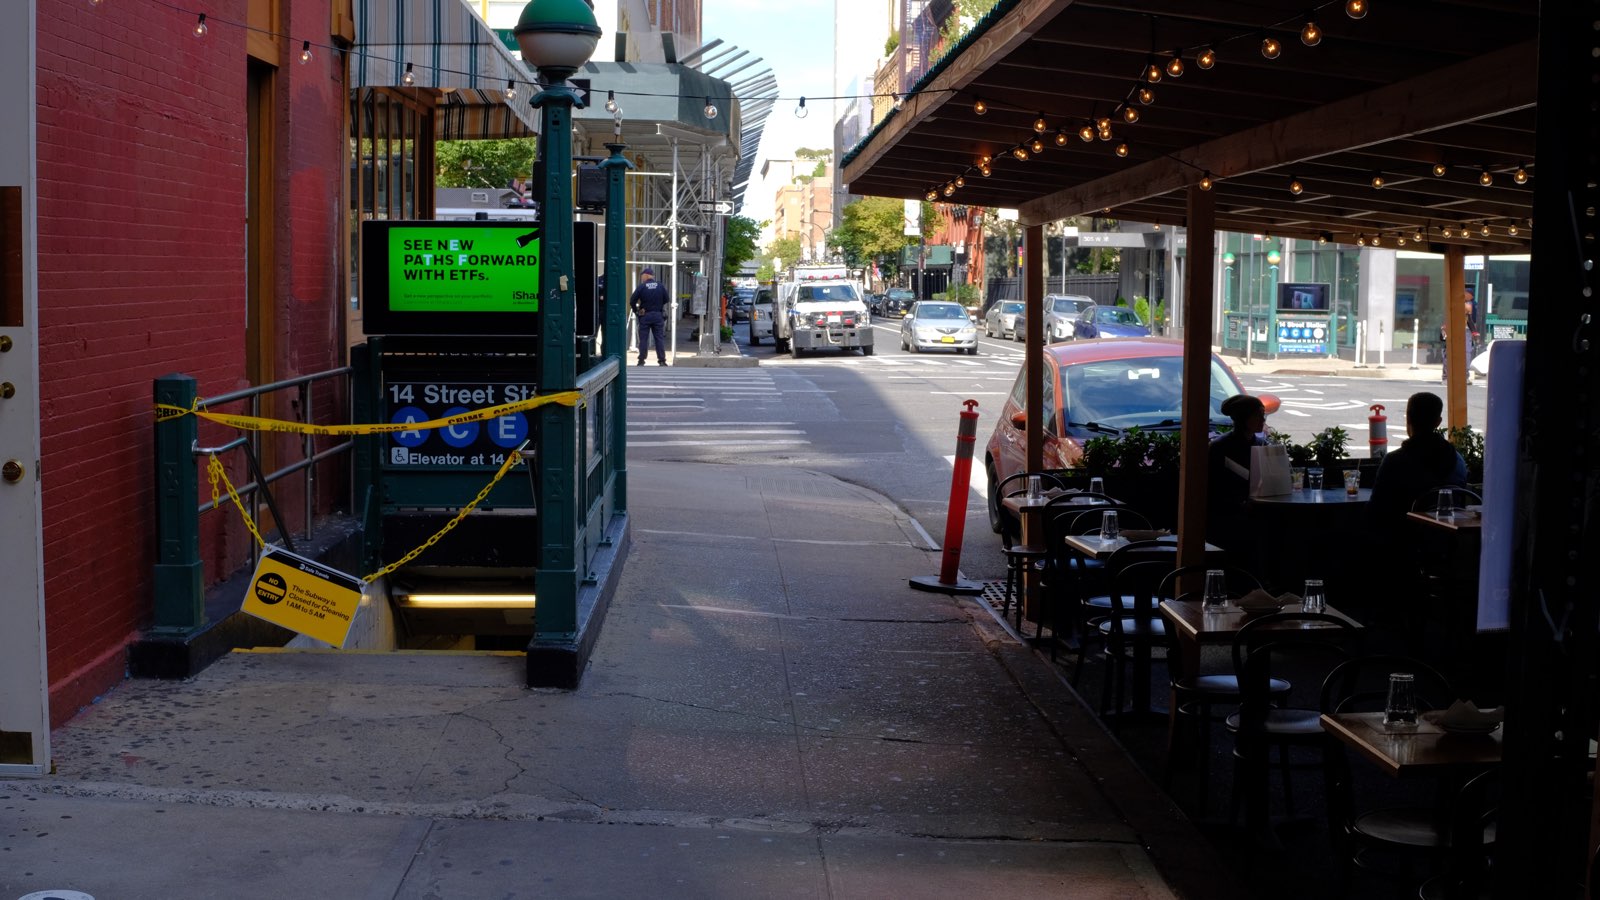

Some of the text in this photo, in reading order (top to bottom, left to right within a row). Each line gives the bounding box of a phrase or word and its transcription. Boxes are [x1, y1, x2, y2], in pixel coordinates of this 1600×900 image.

[404, 239, 474, 251] SEE NEW
[404, 254, 537, 266] PATHS FORWARD
[404, 269, 490, 281] WITH ETFs.
[390, 385, 414, 403] 14
[424, 384, 495, 404] Street
[401, 416, 421, 439] A
[499, 416, 517, 439] E
[409, 453, 465, 465] Elevator
[471, 453, 483, 465] at
[490, 454, 504, 465] 14
[268, 577, 279, 586] NO
[257, 590, 280, 602] ENTRY
[292, 585, 305, 594] The
[305, 590, 331, 605] Subway
[288, 592, 350, 621] Closed for Cleaning
[289, 601, 301, 610] AM
[301, 606, 309, 614] to
[308, 608, 314, 616] 5
[314, 611, 326, 620] AM
